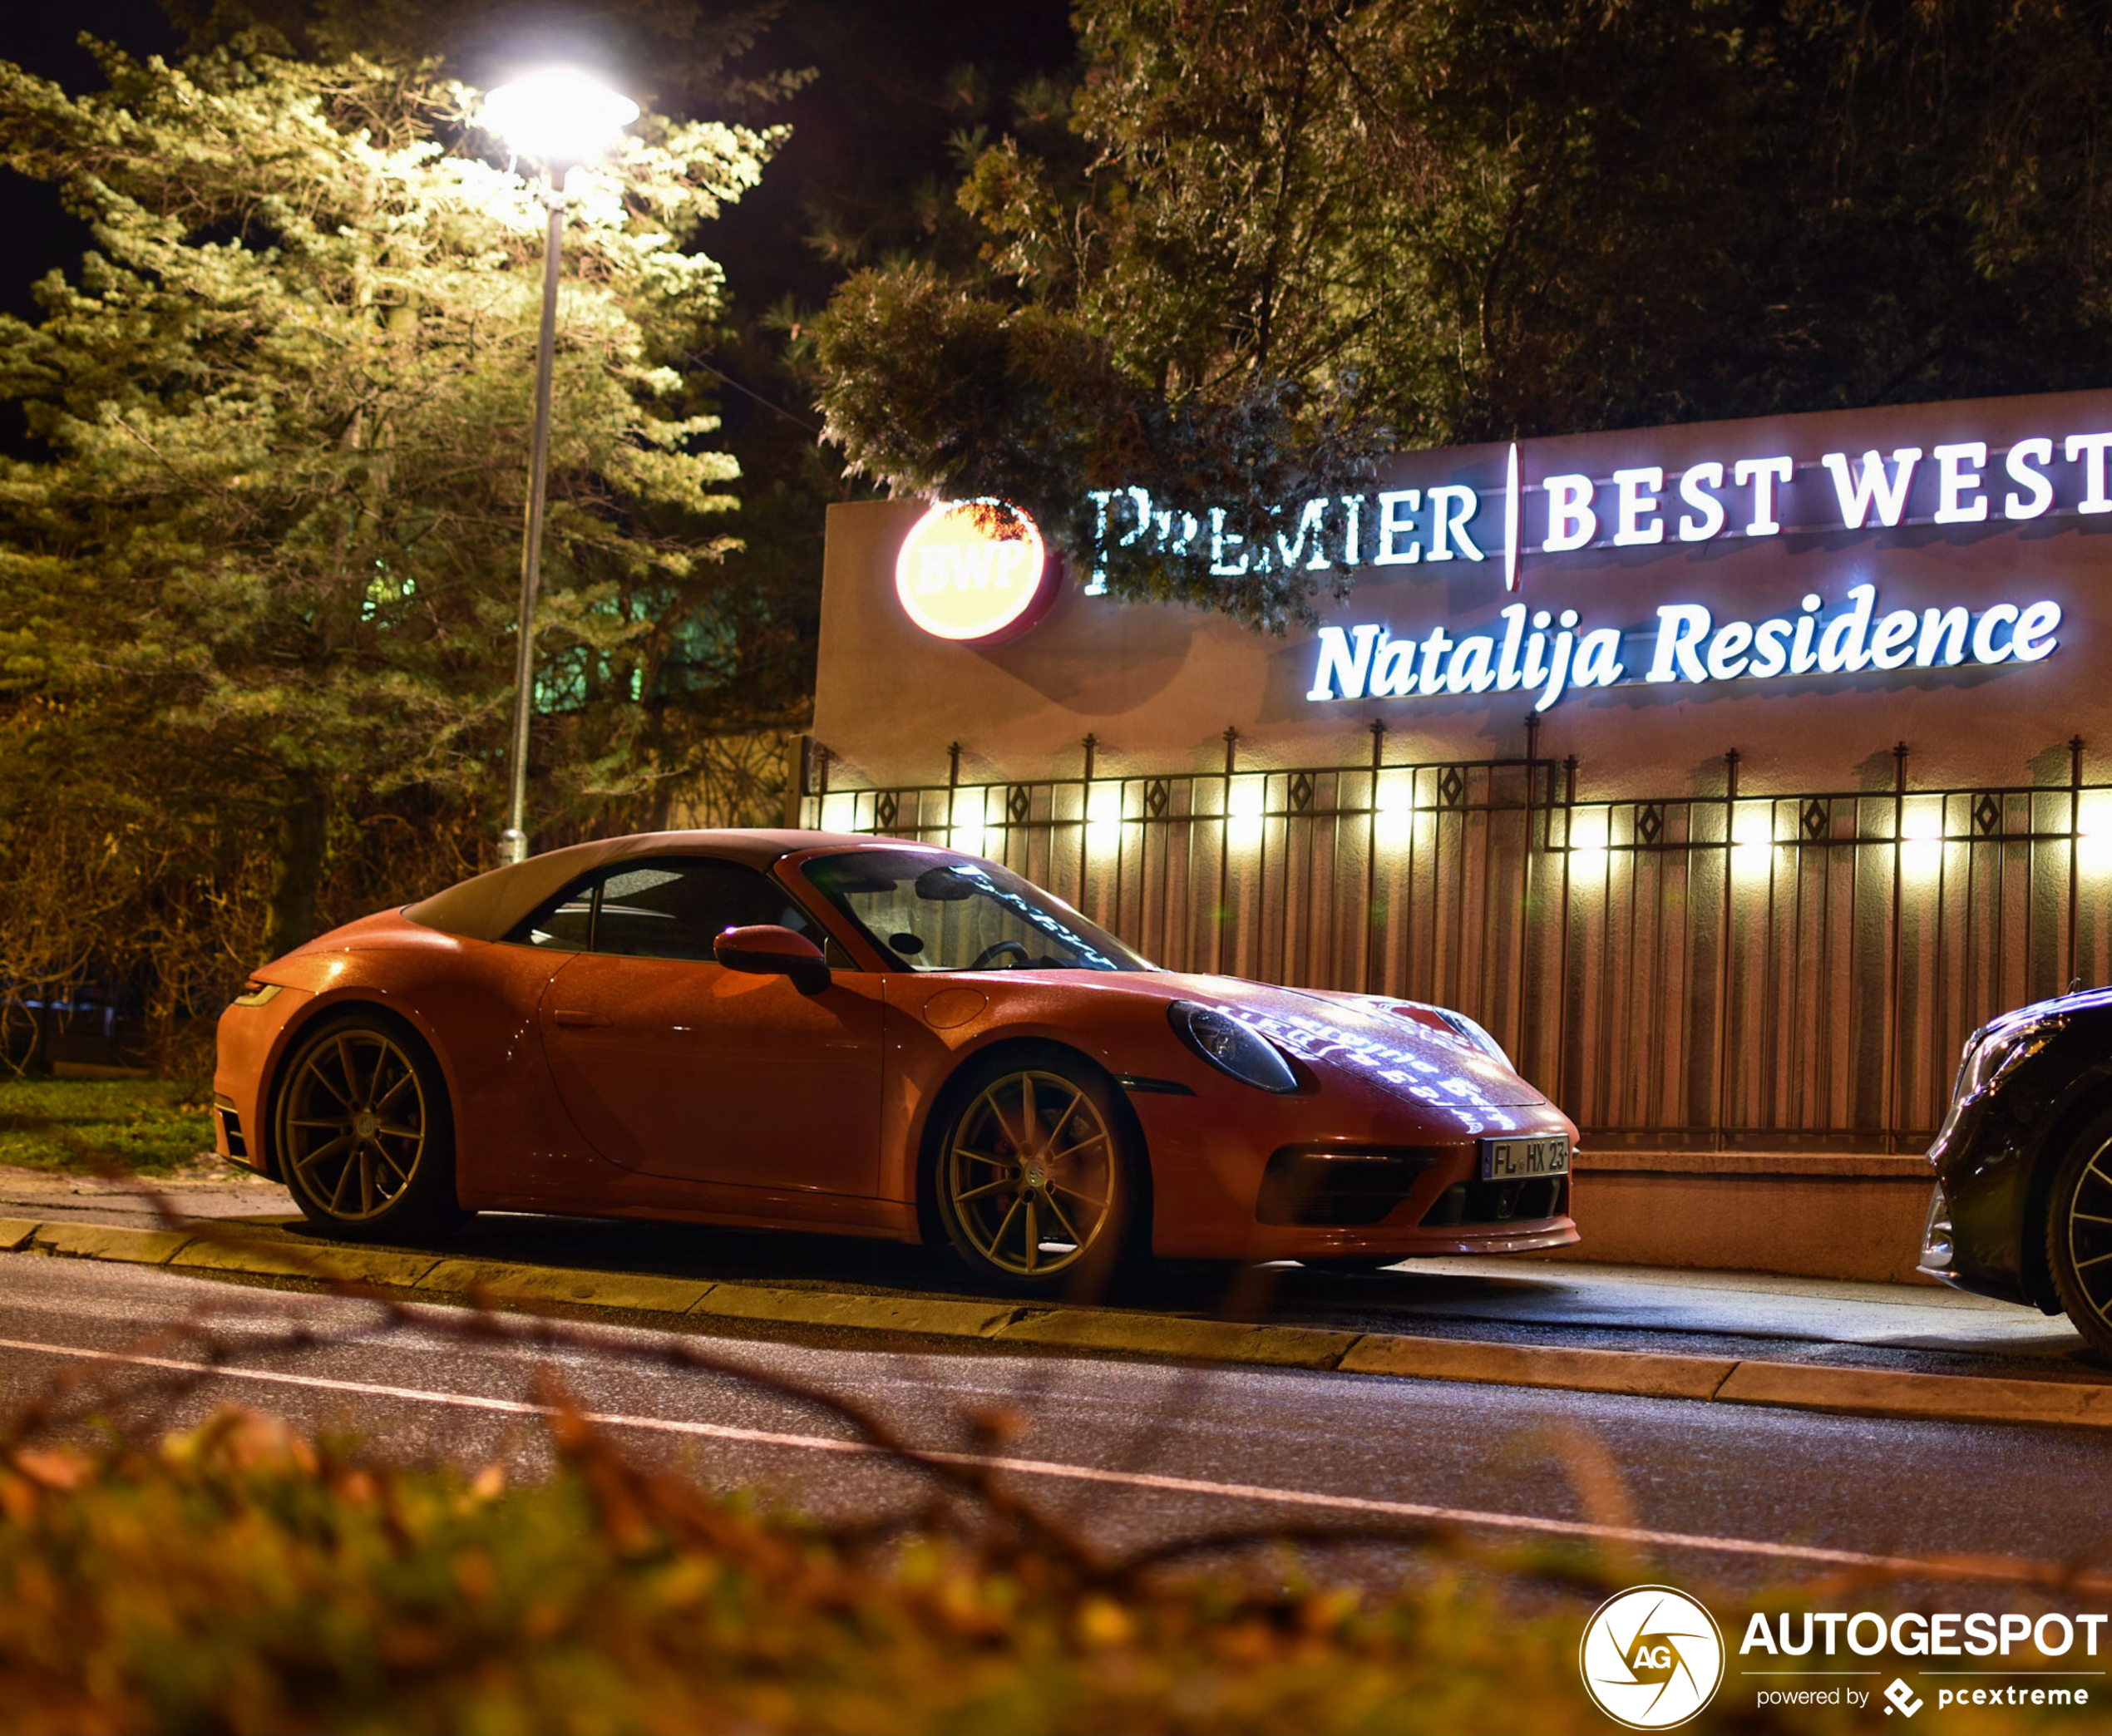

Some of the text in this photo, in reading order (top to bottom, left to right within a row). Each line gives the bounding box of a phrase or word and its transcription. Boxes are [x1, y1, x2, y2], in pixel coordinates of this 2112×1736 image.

[1542, 455, 1794, 553] BEST
[1822, 432, 2112, 530] WEST
[917, 540, 1025, 594] BWP
[1306, 584, 2062, 713] Natalija Residence
[1494, 1143, 1517, 1175] FL
[1527, 1141, 1545, 1172] HX
